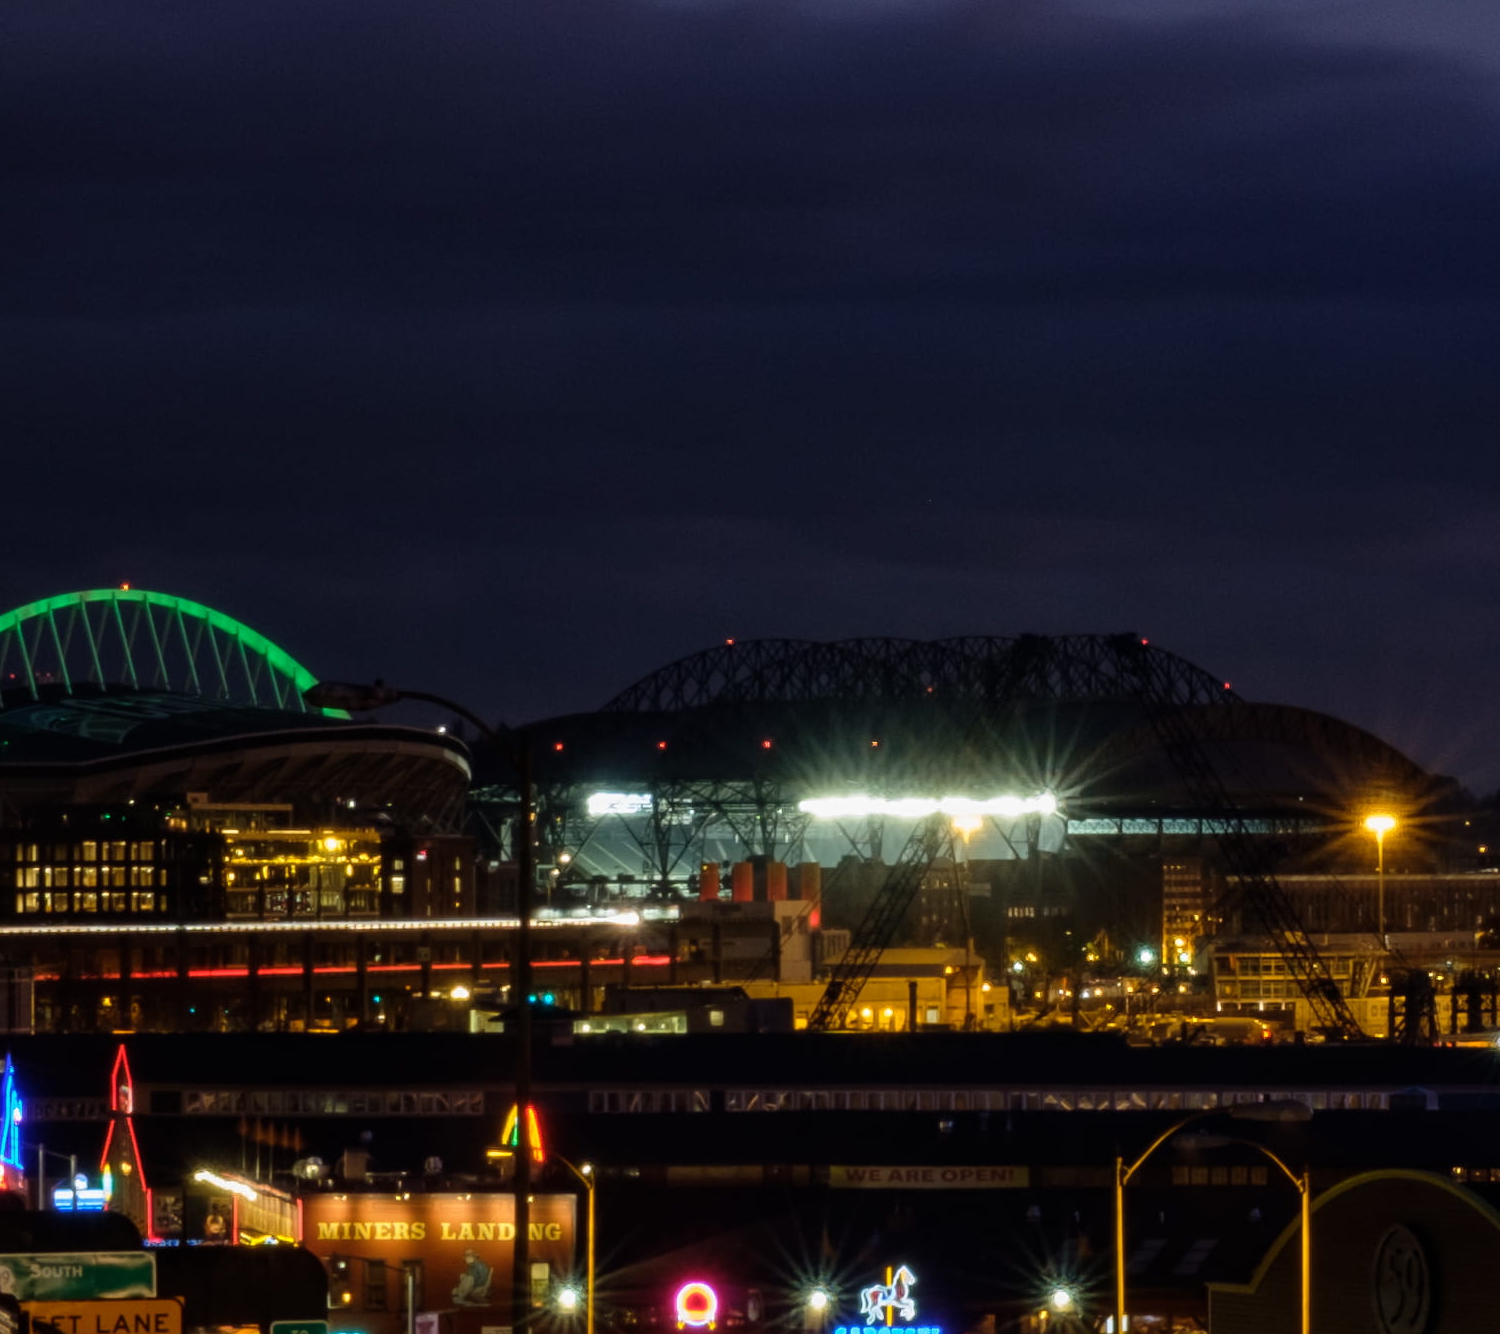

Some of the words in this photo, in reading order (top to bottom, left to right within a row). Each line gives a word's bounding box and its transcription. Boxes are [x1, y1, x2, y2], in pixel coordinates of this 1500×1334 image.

[845, 1168, 881, 1182] WE
[888, 1168, 934, 1182] ARE
[941, 1168, 1014, 1183] OPEN!
[317, 1221, 426, 1241] MINERS
[440, 1221, 562, 1241] LANDNG
[28, 1264, 84, 1279] SOUTH
[96, 1313, 170, 1334] LANE
